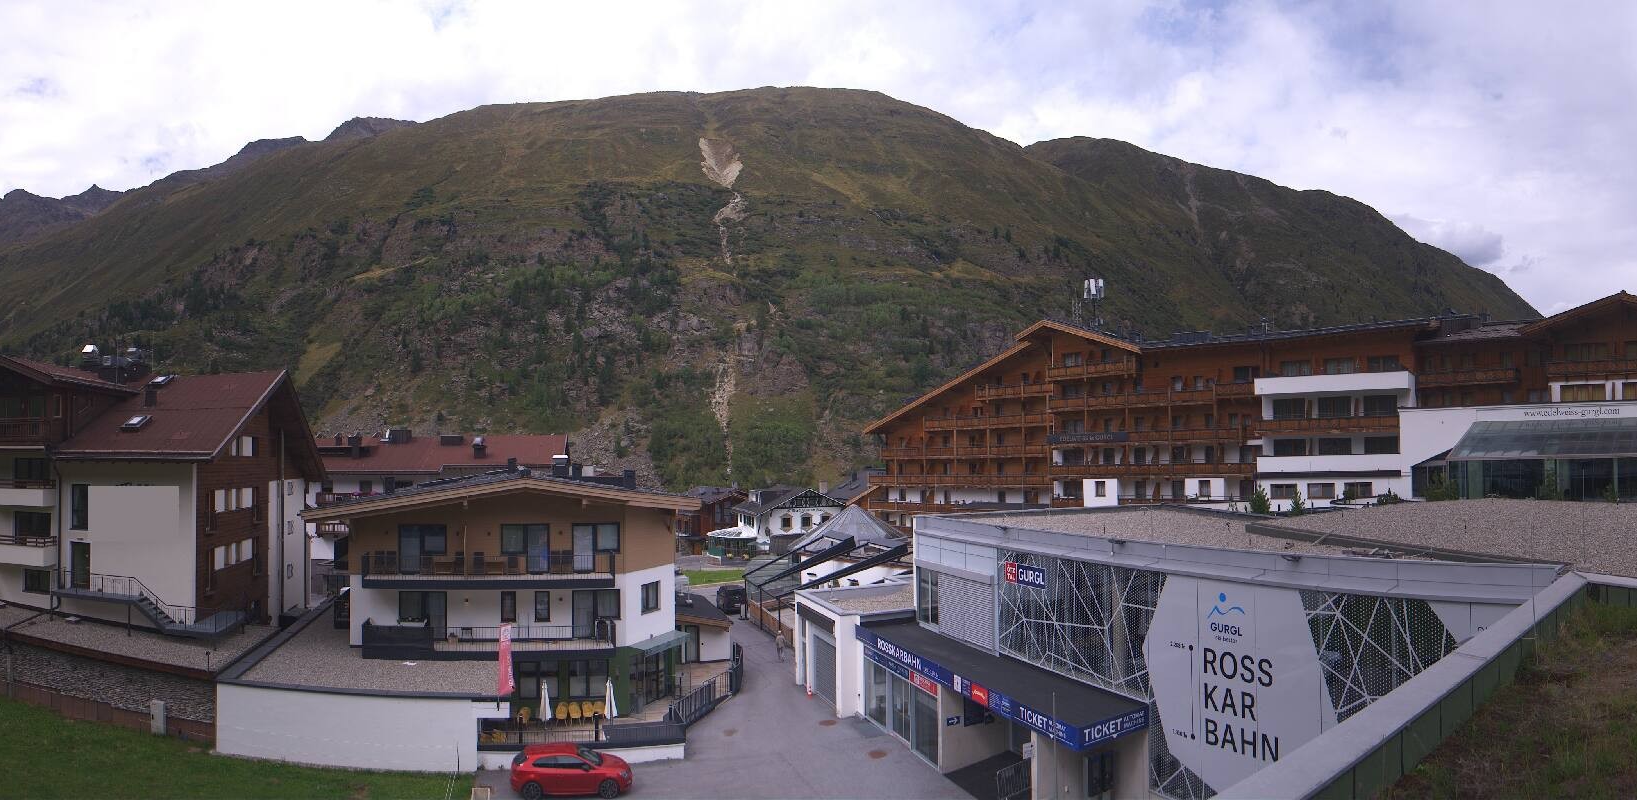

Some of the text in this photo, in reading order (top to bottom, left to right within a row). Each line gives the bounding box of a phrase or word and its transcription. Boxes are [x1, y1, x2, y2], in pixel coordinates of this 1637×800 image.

[1524, 407, 1620, 418] www.edelweiss-gurgl.com
[1018, 568, 1045, 586] GURGL
[1210, 622, 1243, 637] GURGL
[877, 637, 923, 671] ROSSKARBAHN
[1203, 647, 1274, 688] ROSS
[1203, 682, 1257, 722] KAR
[1019, 706, 1048, 731] TICKET
[1083, 717, 1123, 743] TICKET
[1204, 717, 1279, 763] BAHN
